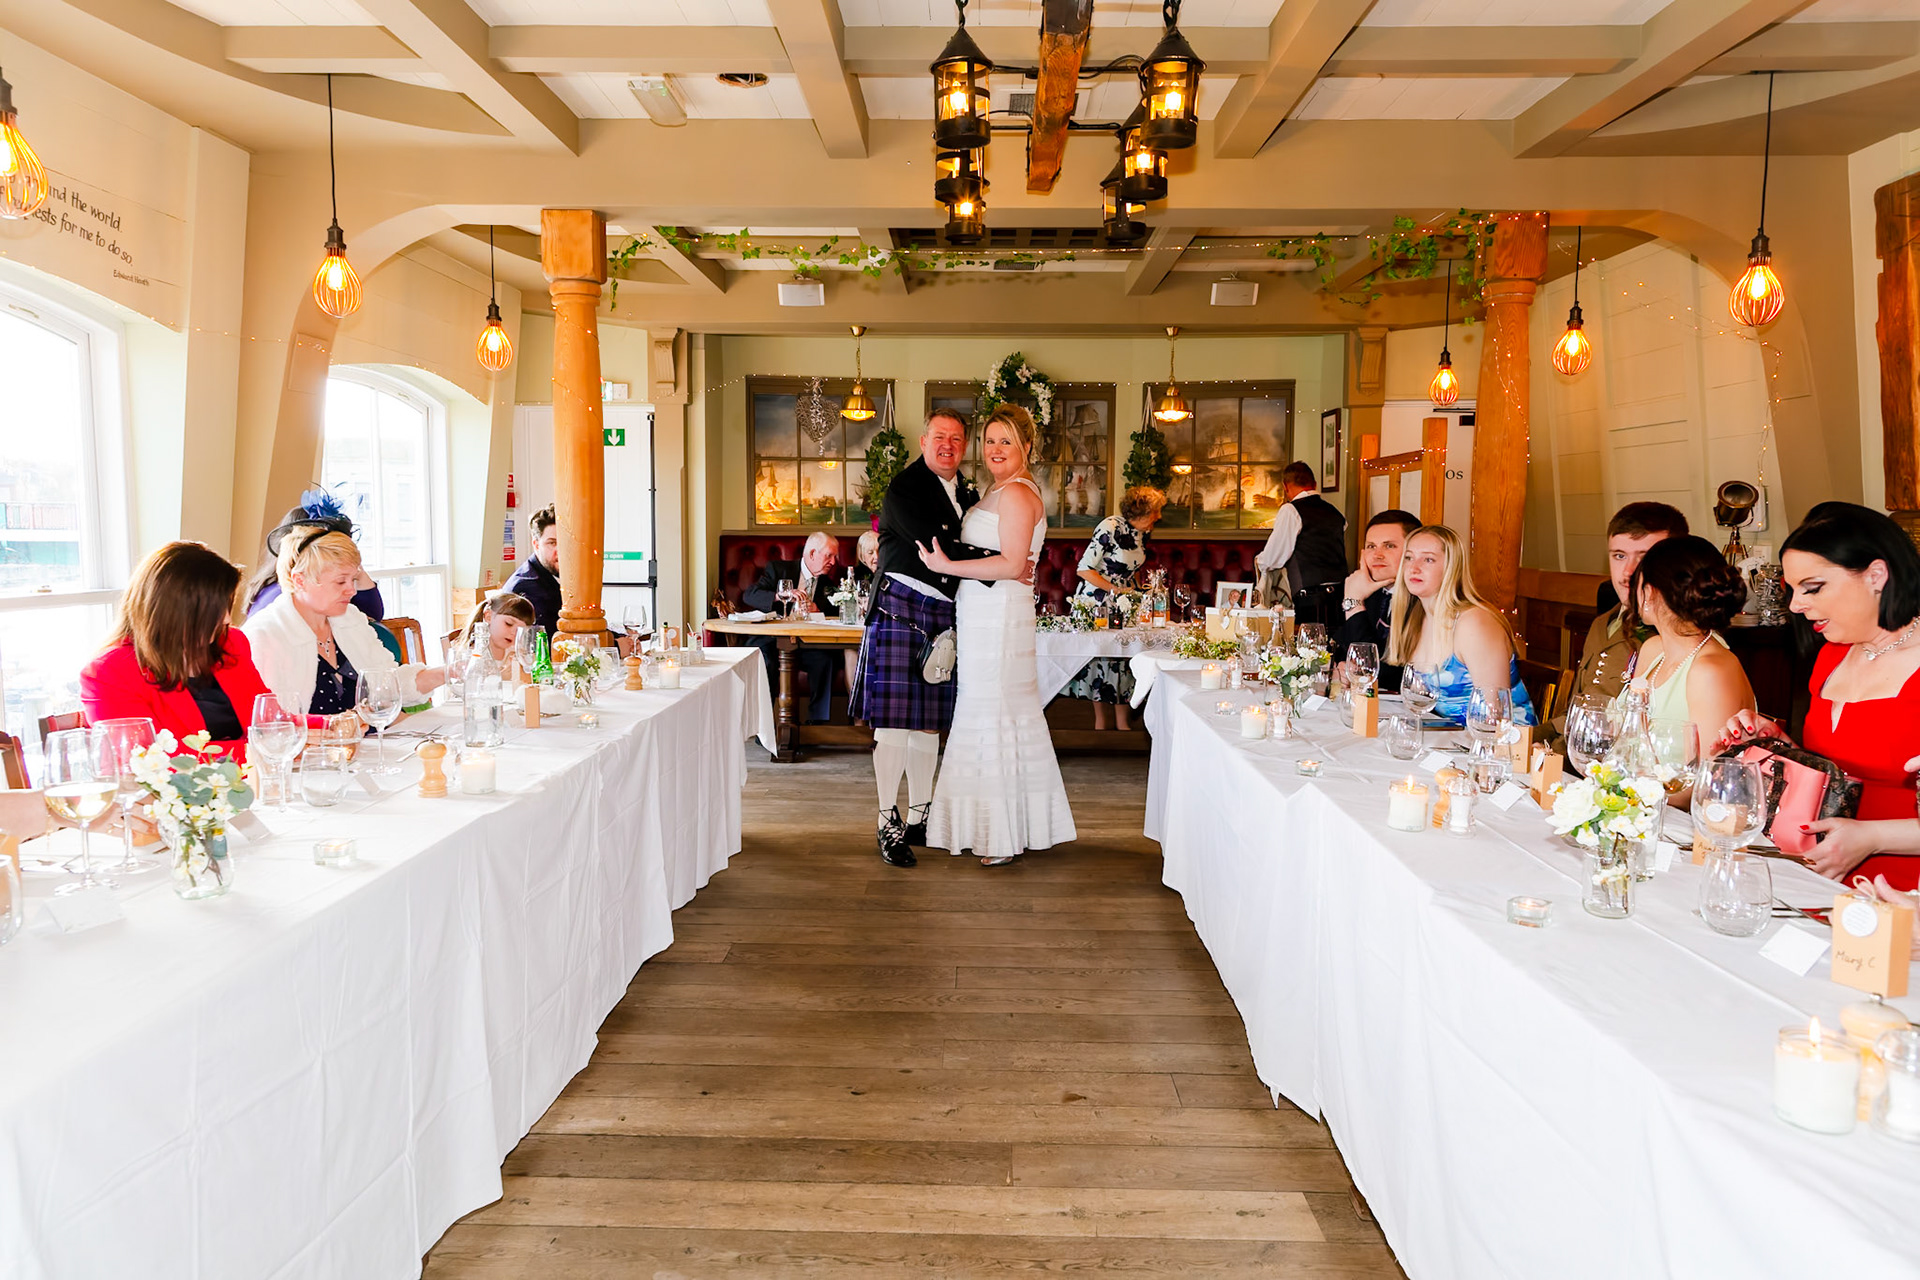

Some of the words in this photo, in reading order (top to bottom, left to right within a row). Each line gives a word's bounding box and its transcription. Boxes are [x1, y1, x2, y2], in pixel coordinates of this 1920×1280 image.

[71, 191, 87, 213] the
[90, 205, 123, 233] world.
[58, 212, 78, 234] for
[79, 227, 94, 242] me
[95, 231, 106, 247] to
[107, 240, 121, 255] do
[1835, 950, 1863, 972] Mary
[1867, 956, 1877, 969] C
